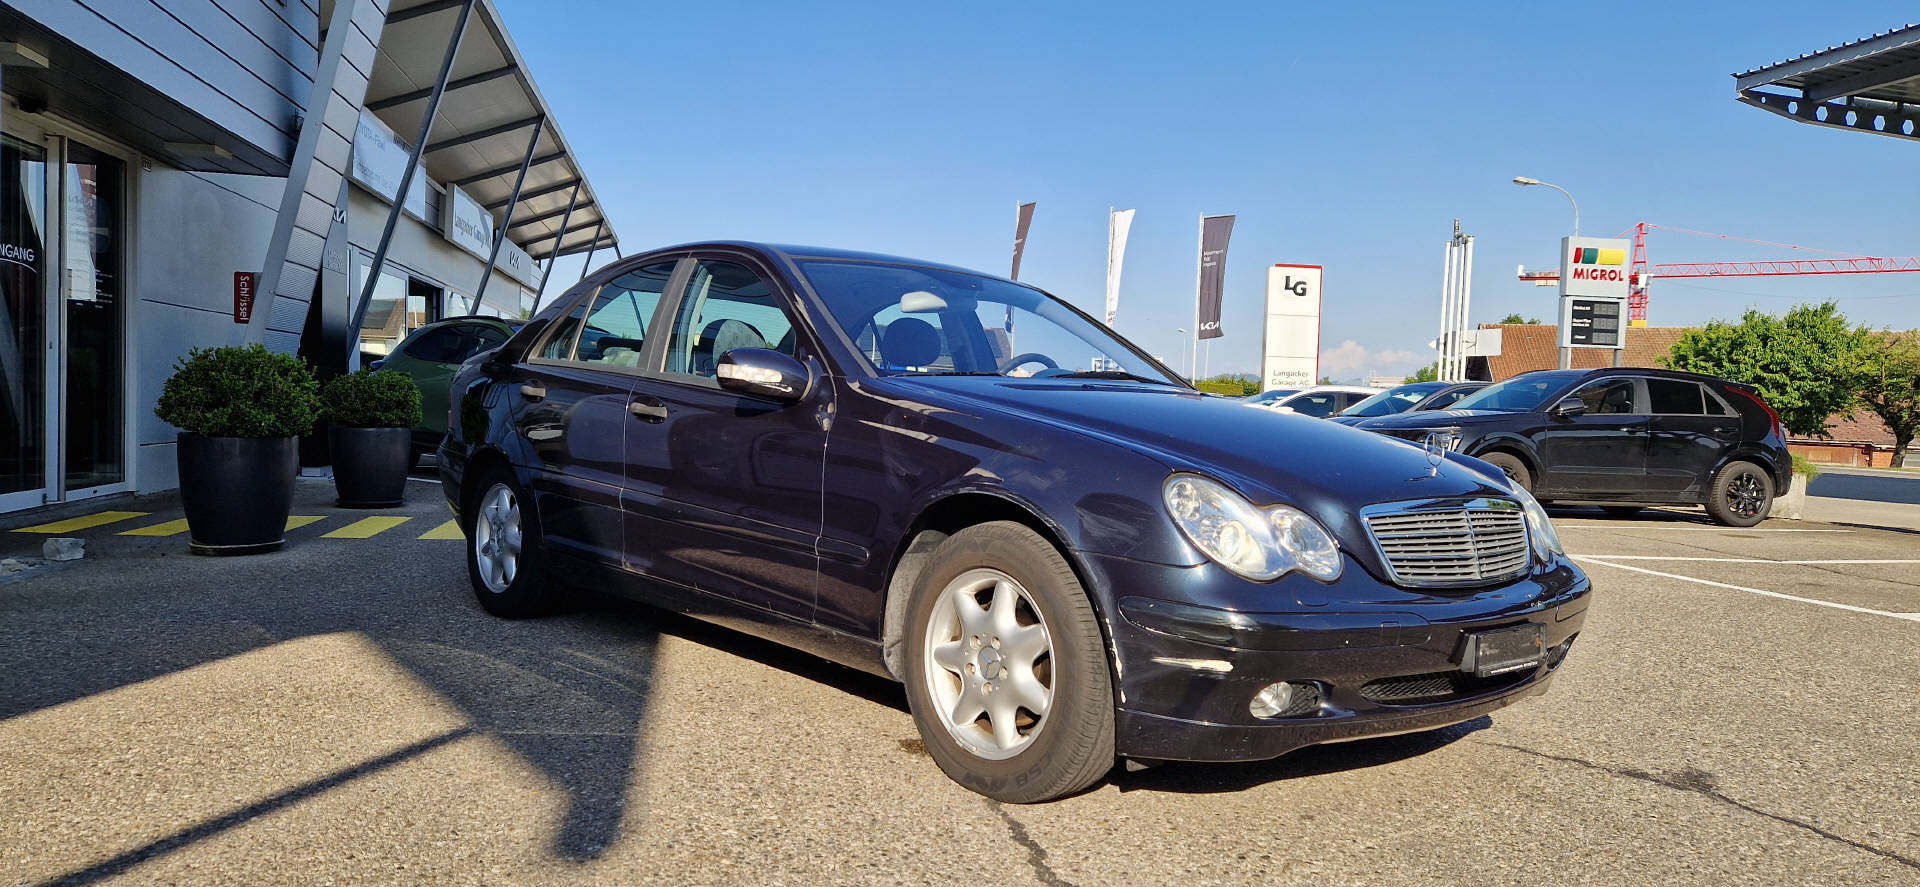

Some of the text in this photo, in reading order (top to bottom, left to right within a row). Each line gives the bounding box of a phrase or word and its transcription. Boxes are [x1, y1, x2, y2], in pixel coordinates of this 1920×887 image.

[1572, 268, 1624, 282] MIGROL
[1284, 275, 1307, 297] LG
[239, 275, 250, 321] Schlüssel
[1273, 369, 1309, 378] Langacker
[1271, 379, 1297, 387] Garage
